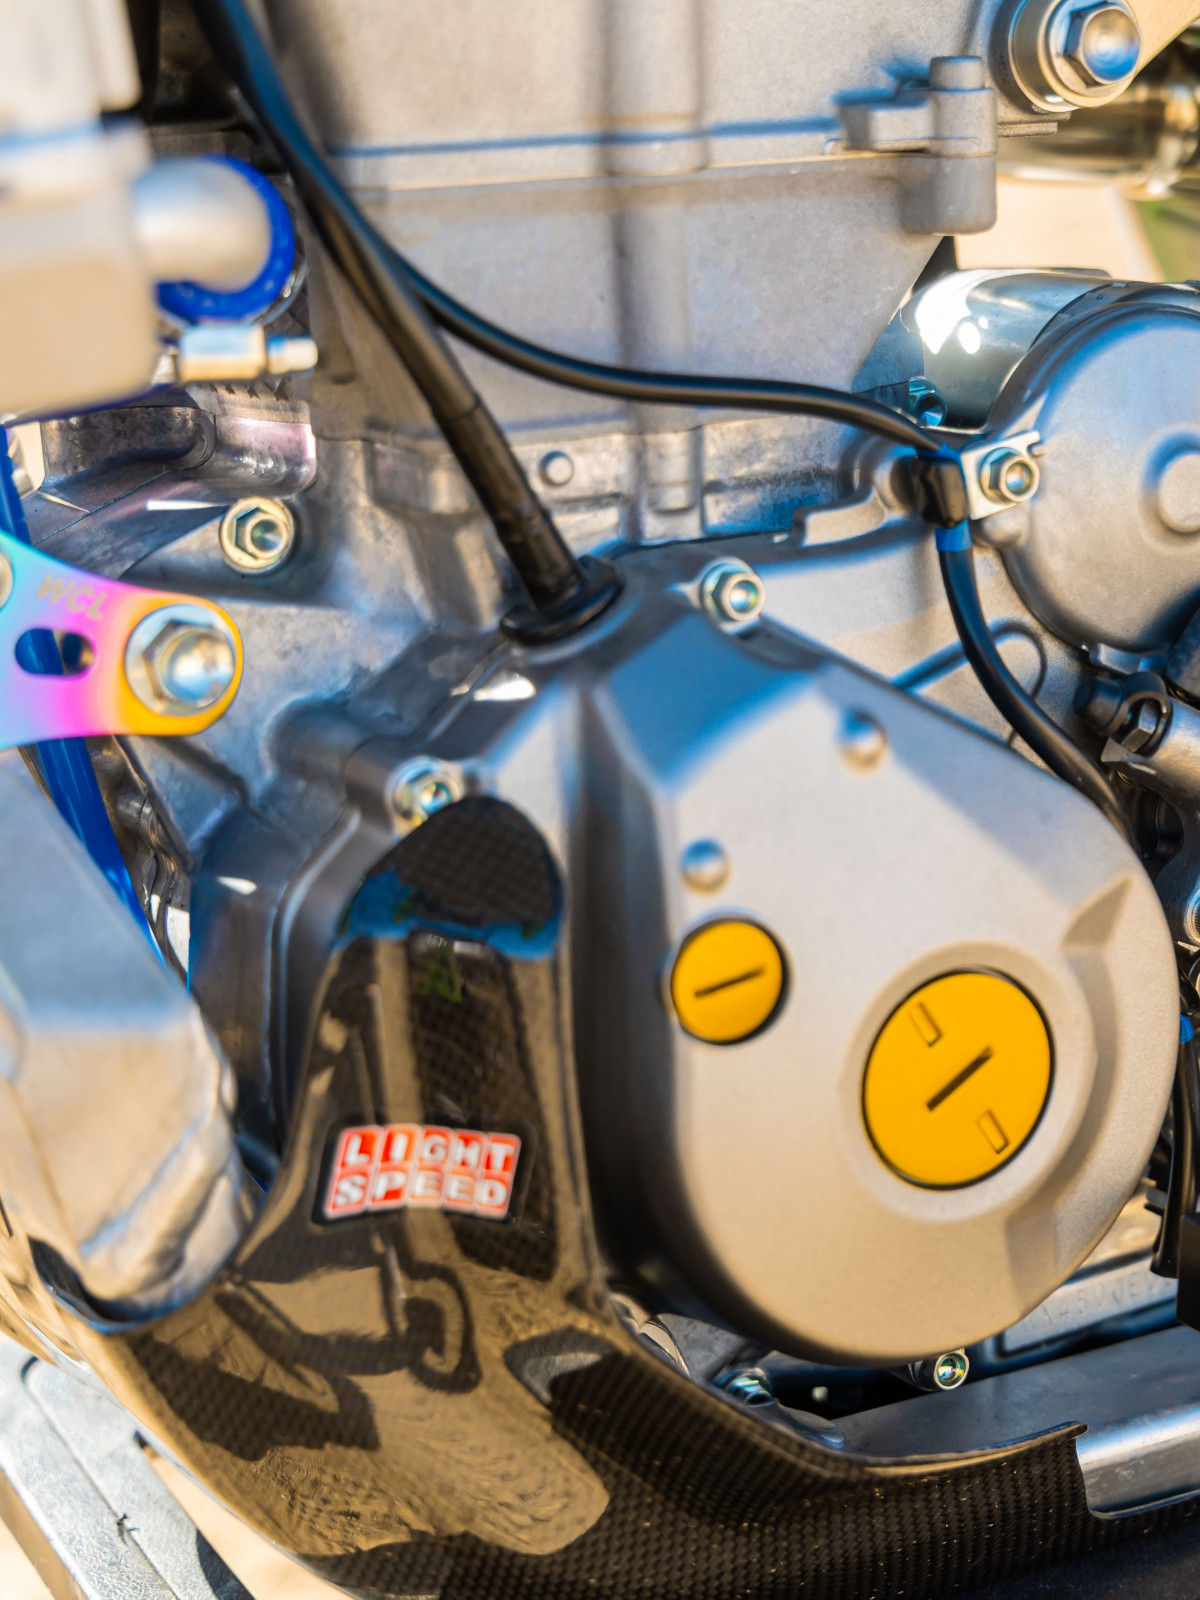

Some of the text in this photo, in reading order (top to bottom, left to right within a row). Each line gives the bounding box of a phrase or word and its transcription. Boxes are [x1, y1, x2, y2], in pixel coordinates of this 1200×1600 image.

[36, 573, 108, 622] WCL
[344, 1132, 516, 1172] LIGHT
[334, 1169, 508, 1206] SPEED
